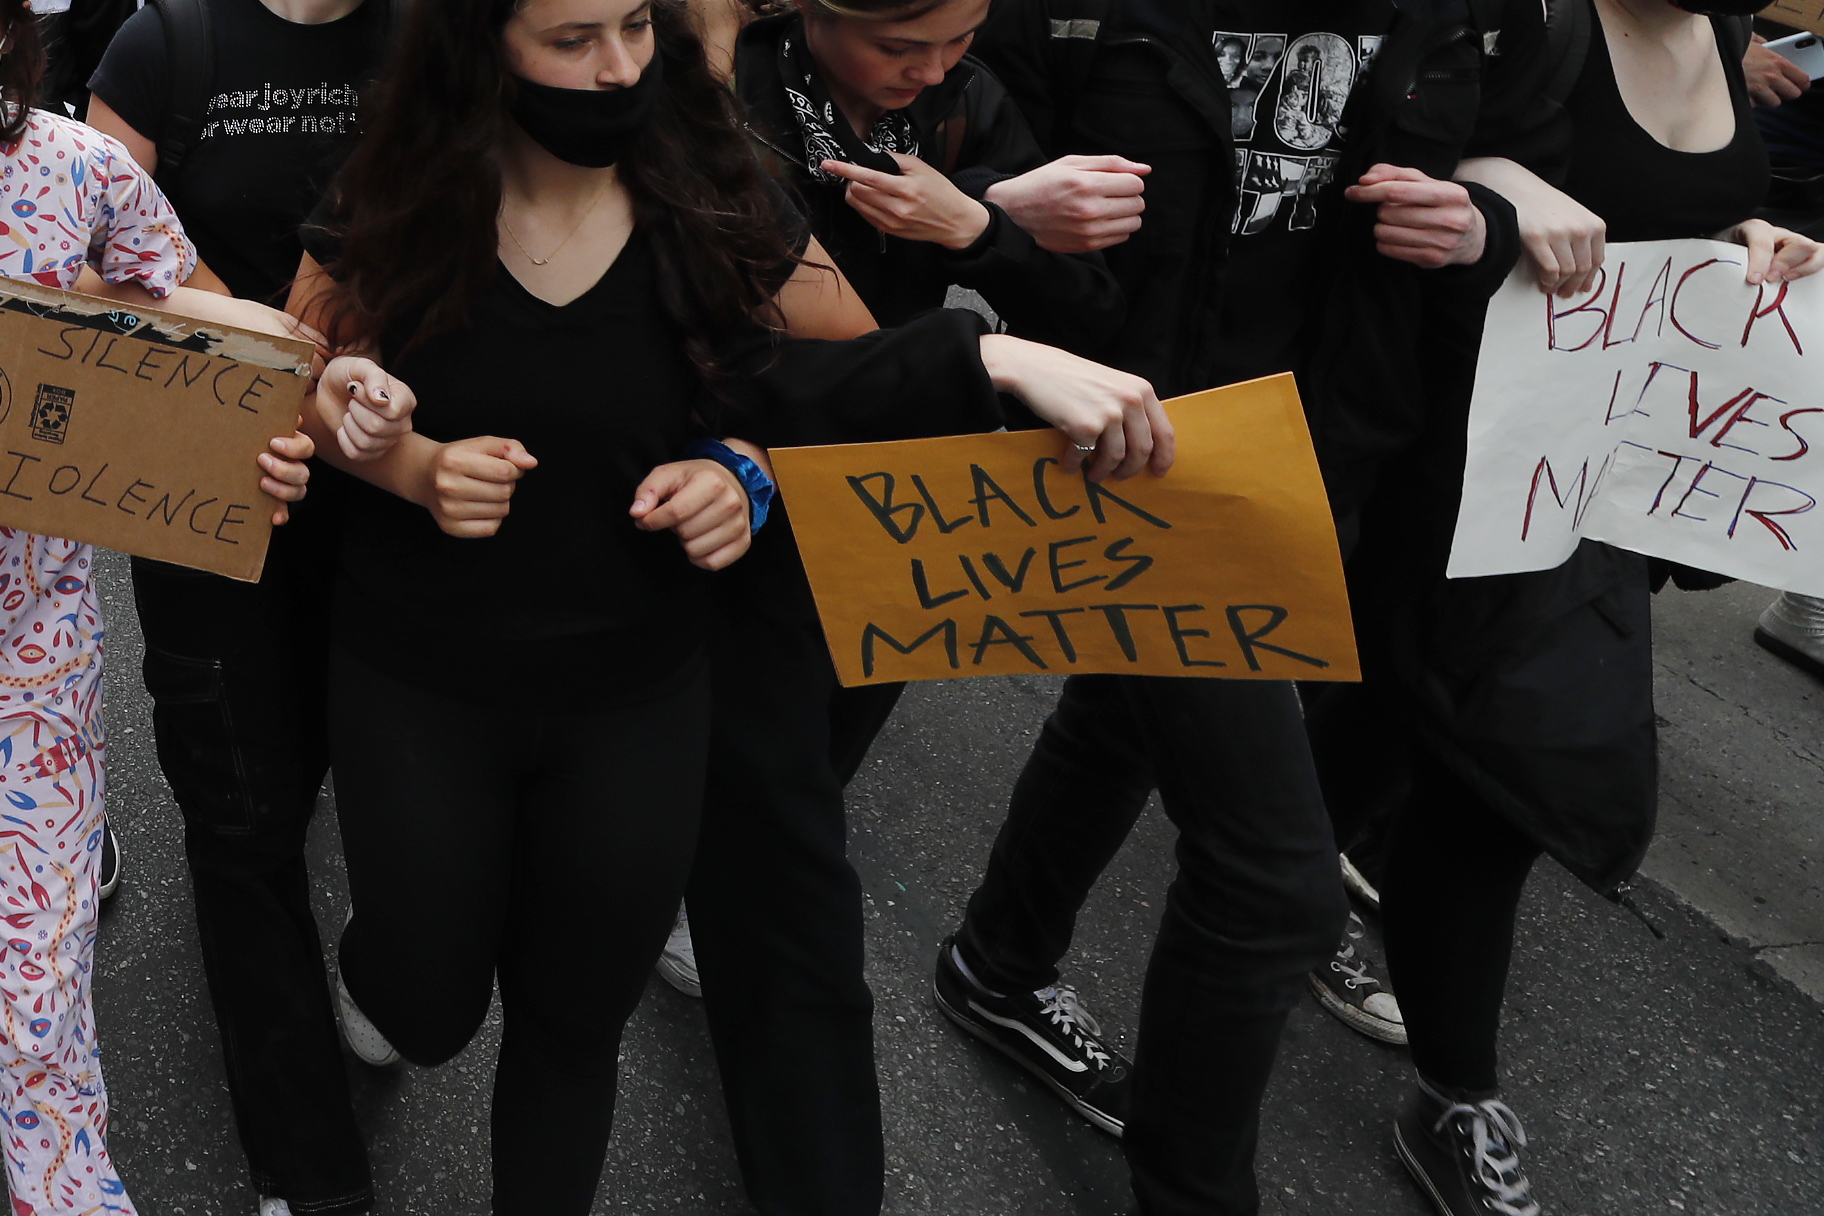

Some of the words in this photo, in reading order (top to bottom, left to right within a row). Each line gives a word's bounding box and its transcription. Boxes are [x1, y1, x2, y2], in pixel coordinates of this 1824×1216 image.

[223, 116, 296, 136] wear
[258, 82, 359, 111] joyrich
[1546, 256, 1803, 356] BLACK
[38, 325, 274, 414] SILENCE
[46, 394, 68, 403] PAPER
[1606, 361, 1824, 461] LIVES
[846, 457, 1173, 544] BLACK
[911, 536, 1153, 611] LIVES
[861, 603, 1330, 678] MATTER
